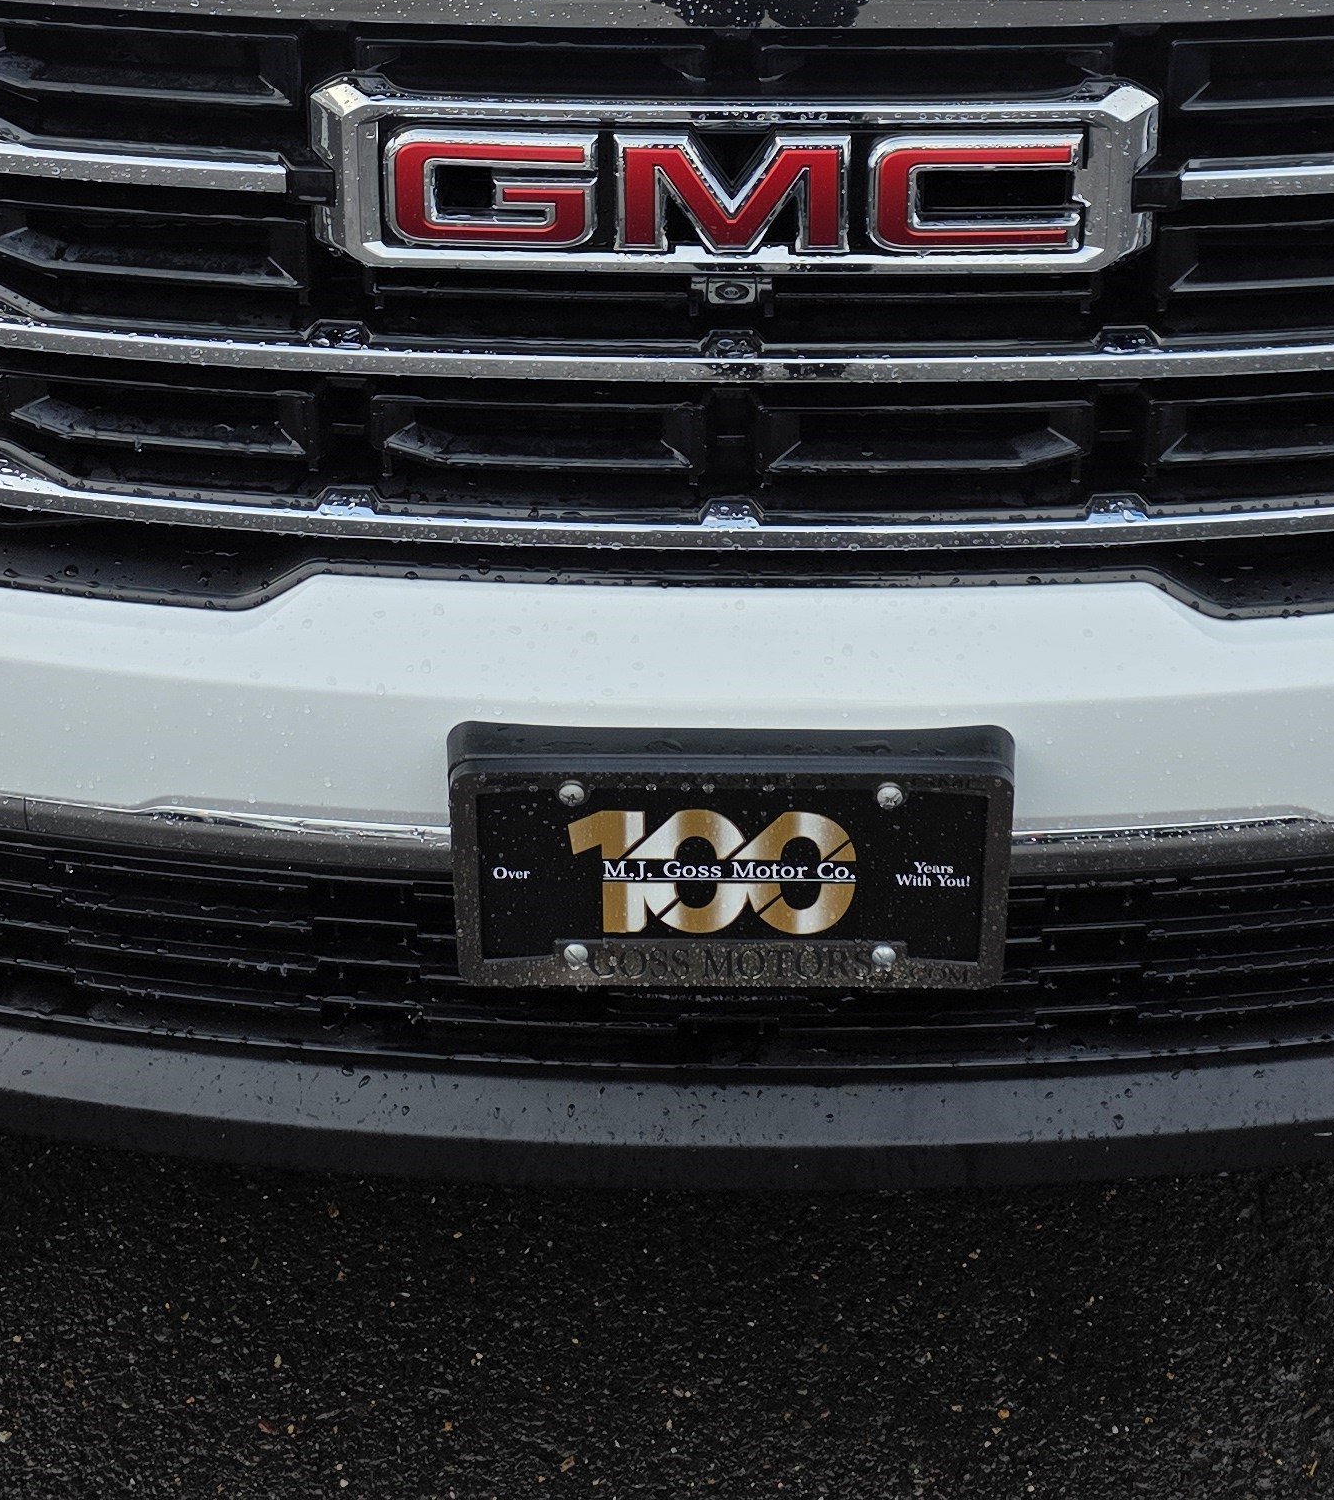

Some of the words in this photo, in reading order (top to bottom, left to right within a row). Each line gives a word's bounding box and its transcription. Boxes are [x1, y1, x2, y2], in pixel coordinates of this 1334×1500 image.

[385, 130, 1085, 253] GMC
[493, 866, 530, 879] Over
[568, 809, 857, 934] 100
[602, 860, 653, 880] M.J.
[663, 860, 722, 879] Goss
[731, 861, 808, 879] Motor
[817, 861, 856, 880] Co.
[914, 861, 954, 874] Years
[895, 874, 932, 887] With
[937, 874, 971, 887] You!
[589, 946, 691, 979] GOSS
[703, 946, 873, 980] MOTORS
